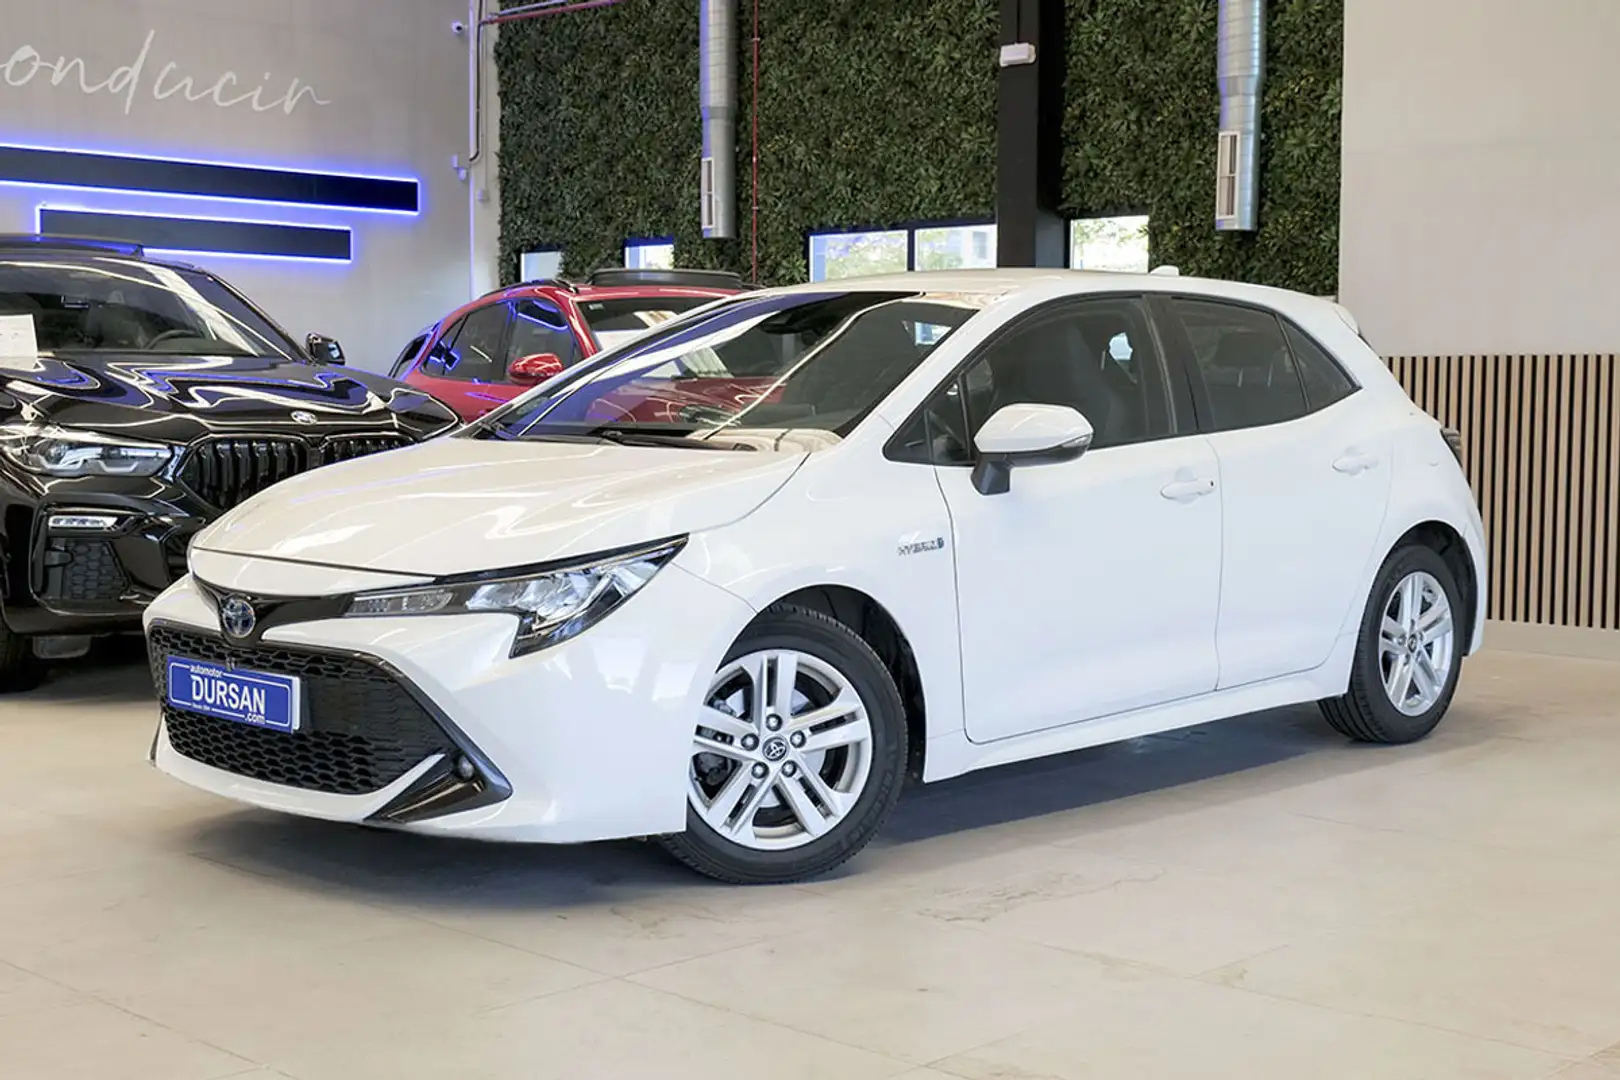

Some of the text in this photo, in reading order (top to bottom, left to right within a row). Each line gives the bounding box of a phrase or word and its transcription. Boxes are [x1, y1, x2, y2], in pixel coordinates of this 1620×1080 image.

[0, 29, 331, 114] onducir
[190, 664, 222, 678] automotor
[190, 674, 266, 715] DURSAN
[244, 712, 266, 725] .com
